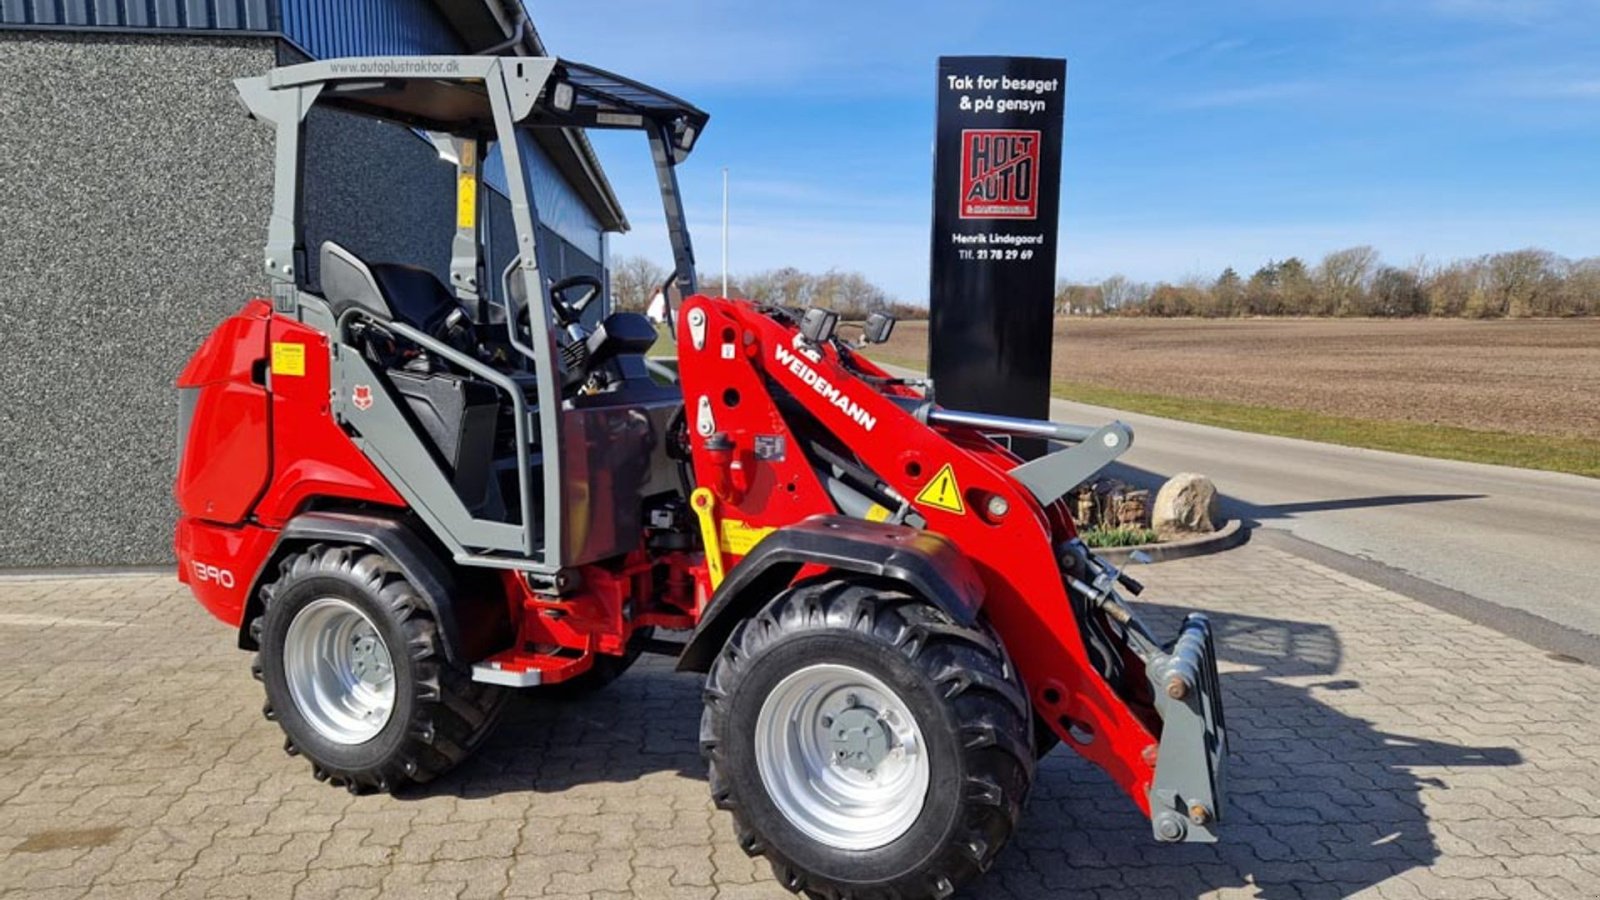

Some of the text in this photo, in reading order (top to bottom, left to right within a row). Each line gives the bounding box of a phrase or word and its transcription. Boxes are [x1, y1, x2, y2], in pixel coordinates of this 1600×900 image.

[330, 60, 459, 74] www.autoplustraktor.dk
[947, 75, 1058, 94] Tak for besøget
[960, 95, 1045, 114] & på gensyn
[971, 135, 1033, 181] HOLT
[967, 156, 1032, 202] AUTO
[952, 233, 1043, 246] Henrik Lindegaard
[959, 250, 1033, 260] Tlf. 21 78 29 69
[775, 344, 876, 431] WEIDEMANN
[191, 560, 235, 588] 1390
